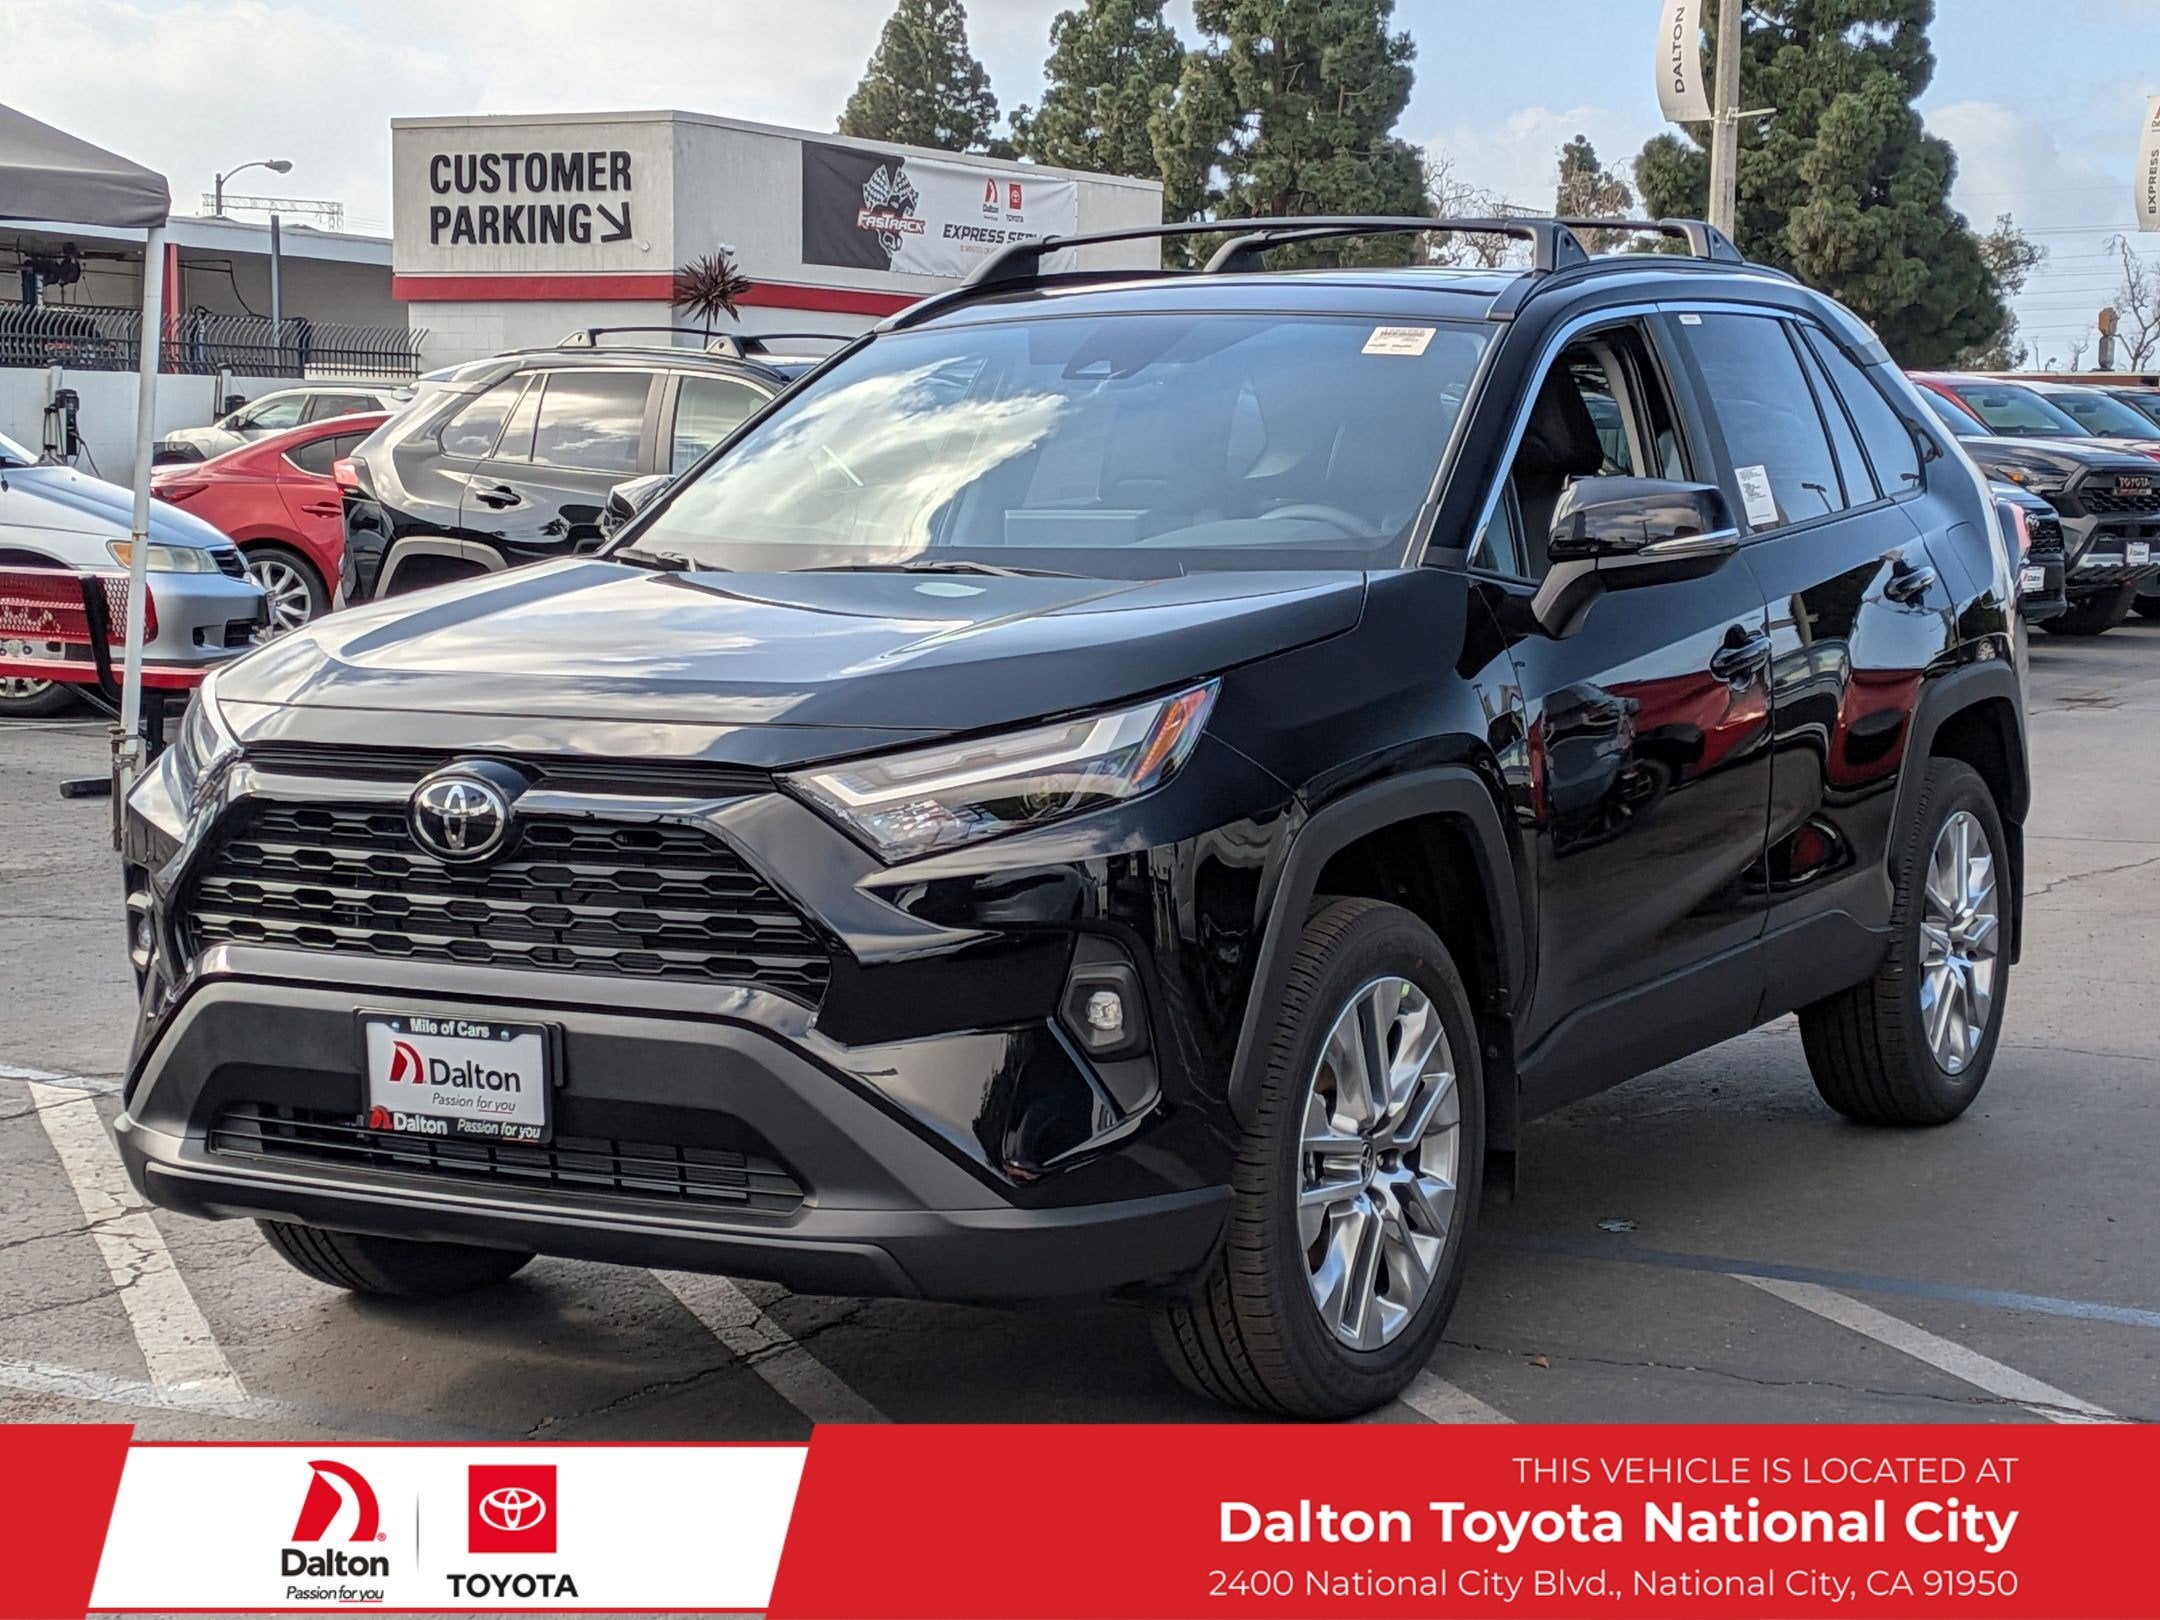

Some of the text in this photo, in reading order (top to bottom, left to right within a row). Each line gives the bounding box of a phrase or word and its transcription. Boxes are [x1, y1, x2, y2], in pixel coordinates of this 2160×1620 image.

[1672, 7, 1685, 93] DALTON
[430, 150, 632, 194] CUSTOMER
[2148, 150, 2159, 214] EXPRESS
[430, 203, 592, 245] PARKING
[942, 223, 1006, 244] EXPRESS
[410, 1018, 490, 1038] Mile of Cars
[429, 1058, 521, 1092] Dalton
[432, 1092, 516, 1113] Passion for you
[393, 1112, 448, 1135] Dalton
[457, 1118, 541, 1139] Passion for you
